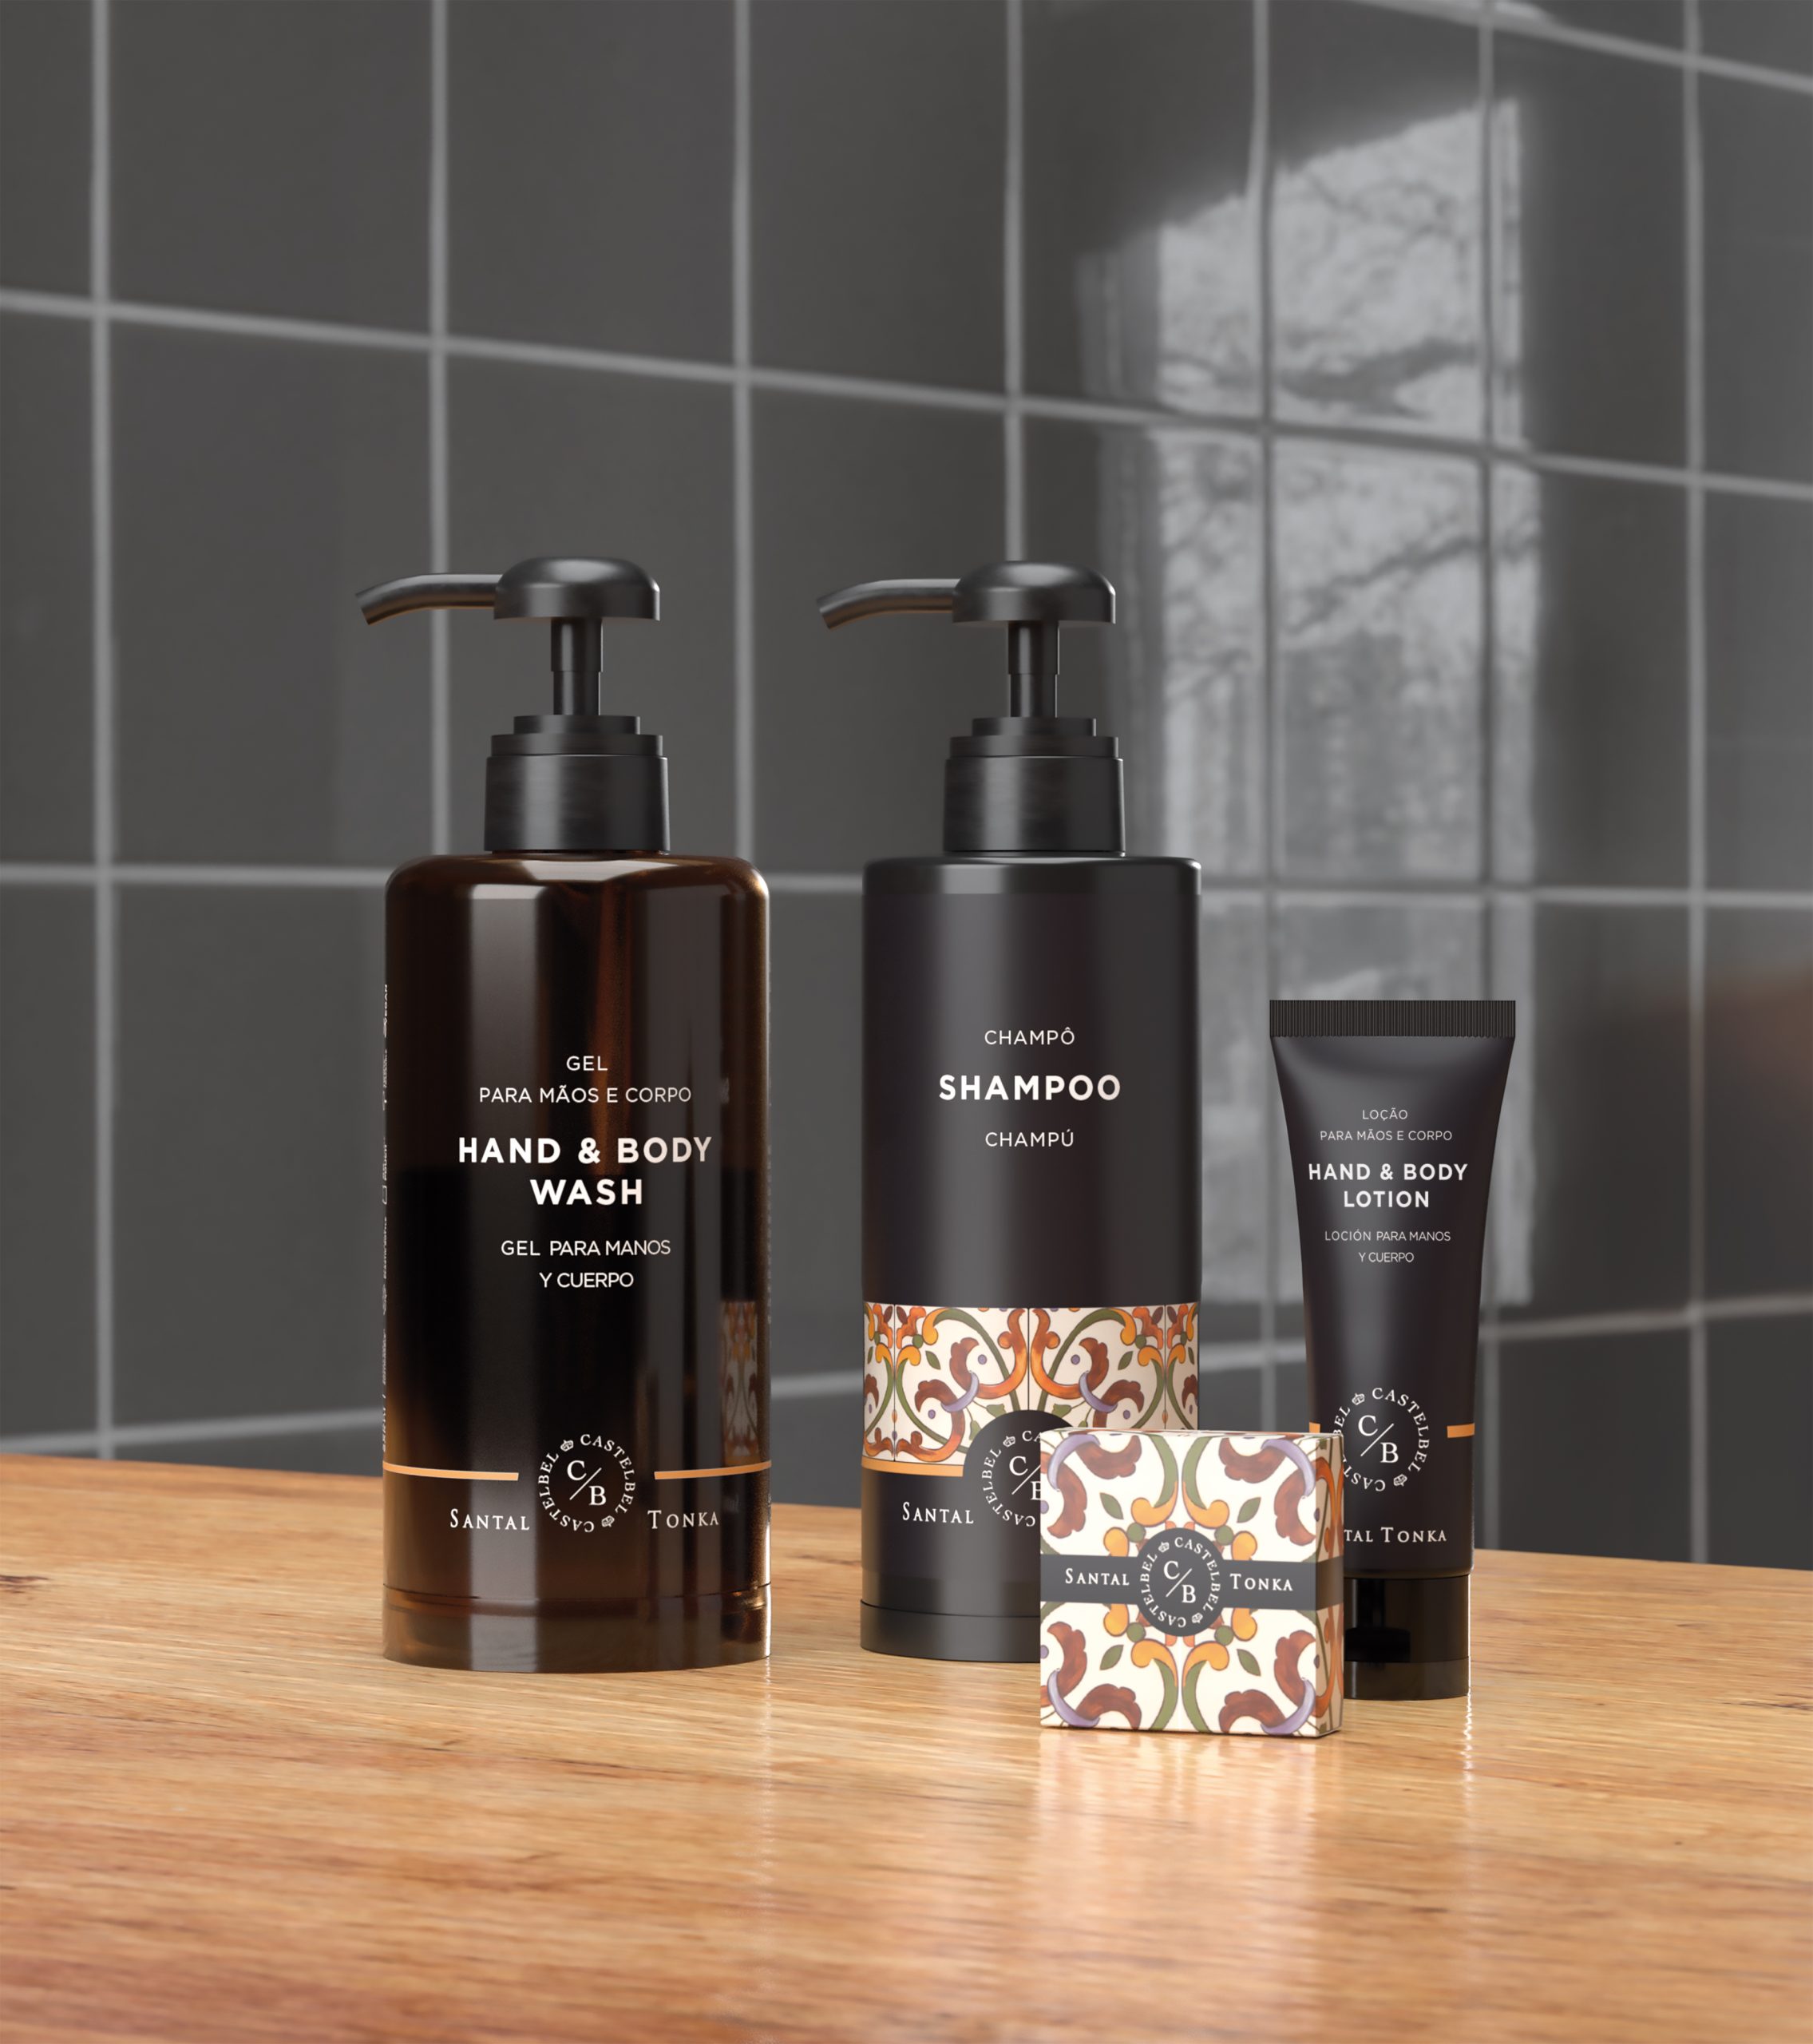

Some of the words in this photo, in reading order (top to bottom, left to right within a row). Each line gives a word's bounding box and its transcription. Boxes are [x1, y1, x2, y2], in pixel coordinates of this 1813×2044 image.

[984, 1026, 1075, 1045] CHAMPÔ
[566, 1056, 608, 1072] GEL
[479, 1087, 532, 1103] PARA
[540, 1084, 600, 1103] MÃOS
[607, 1087, 619, 1103] E
[625, 1087, 691, 1103] CORPO
[939, 1074, 1121, 1101] SHAMPOO
[1362, 1107, 1408, 1121] LOÇÃO
[984, 1128, 1074, 1147] CHAMPÚ
[1320, 1130, 1353, 1141] PARA
[1356, 1128, 1393, 1141] MÃOS
[1396, 1130, 1404, 1141] E
[1407, 1130, 1453, 1141] CORPO
[458, 1137, 561, 1164] HAND
[577, 1137, 601, 1164] &
[617, 1136, 712, 1163] BODY
[1308, 1163, 1371, 1181] HAND
[1380, 1163, 1394, 1181] &
[1403, 1163, 1468, 1181] BODY
[529, 1178, 643, 1206] WASH
[1344, 1190, 1430, 1208] LOTION
[1324, 1228, 1372, 1242] LOCIÓN
[1376, 1230, 1407, 1242] PARA
[1409, 1230, 1451, 1242] MANOS
[501, 1240, 541, 1256] GEL
[549, 1240, 601, 1256] PARA
[605, 1239, 671, 1256] MANOS
[1358, 1251, 1366, 1262] Y
[1368, 1251, 1415, 1263] CUERPO
[539, 1272, 552, 1288] Y
[556, 1272, 634, 1288] CUERPO
[1372, 1387, 1430, 1472] CASTELBEL
[1332, 1406, 1386, 1491] CASTEL
[580, 1434, 636, 1515] CASTELBEL
[537, 1452, 595, 1534] CASTELBEL
[981, 1448, 1036, 1527] CASTELBEL
[1344, 1529, 1374, 1543] TAL
[1174, 1536, 1221, 1612] CASTELBEL
[1139, 1552, 1187, 1628] CASTELBEL
